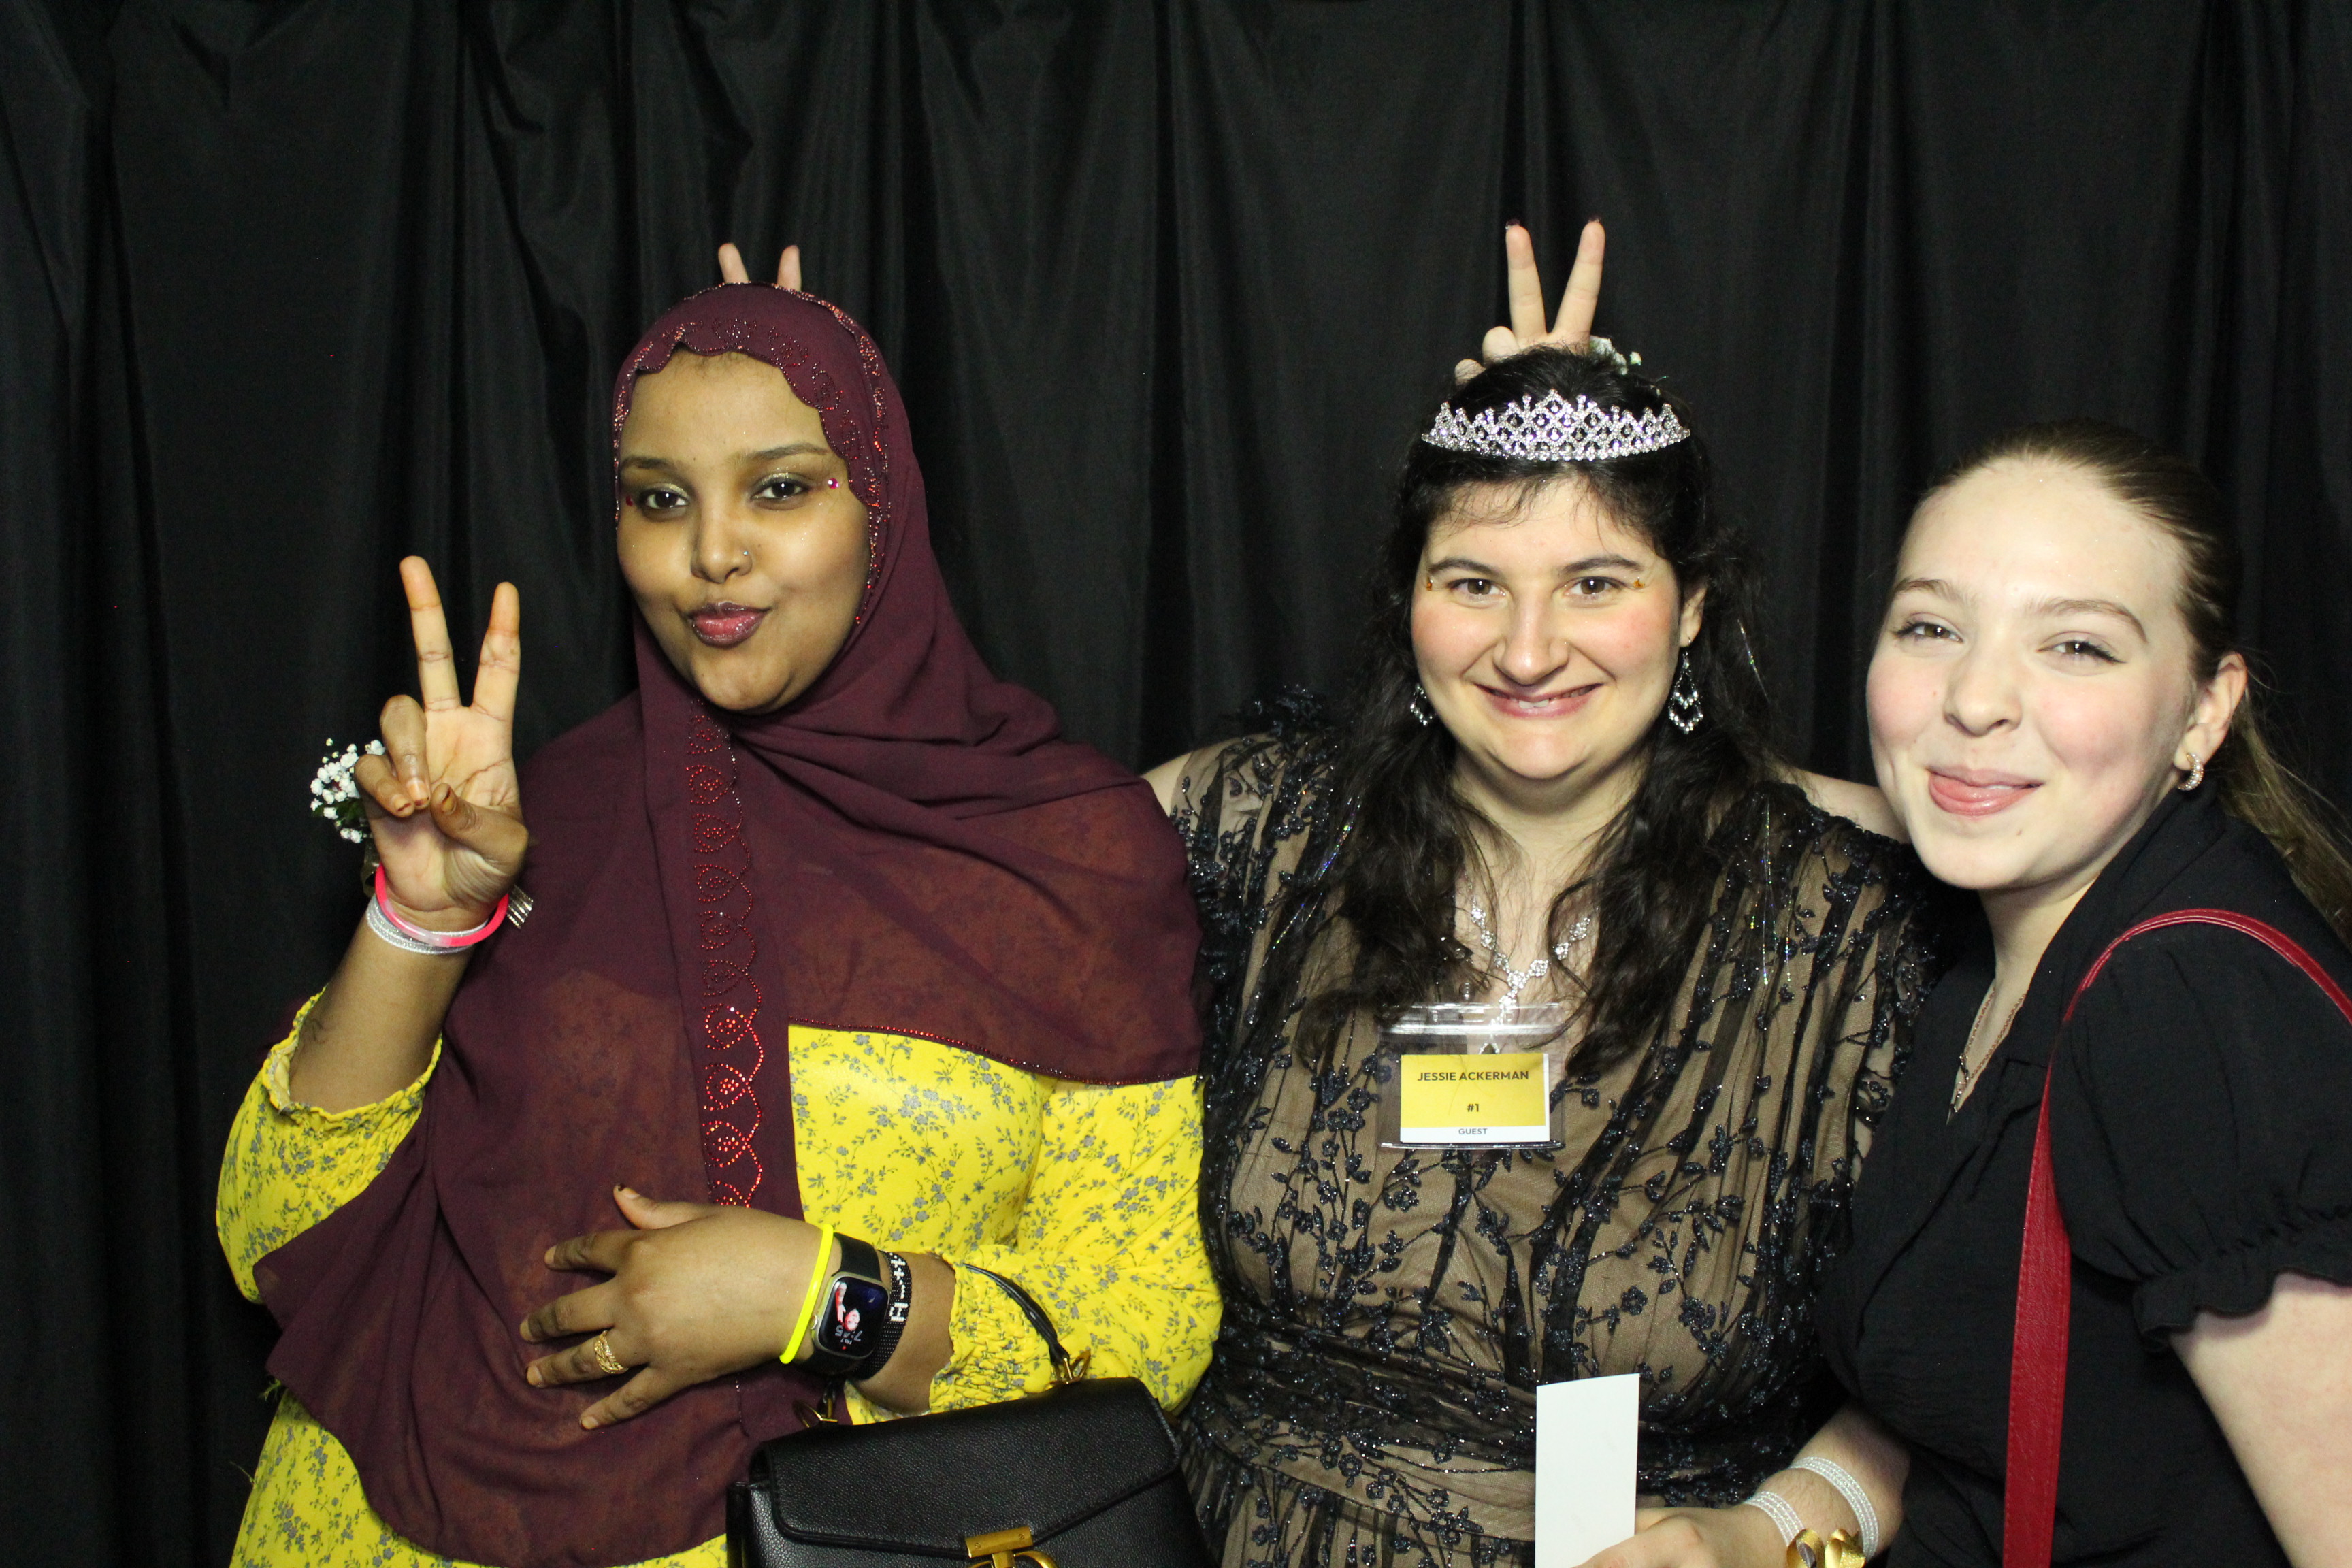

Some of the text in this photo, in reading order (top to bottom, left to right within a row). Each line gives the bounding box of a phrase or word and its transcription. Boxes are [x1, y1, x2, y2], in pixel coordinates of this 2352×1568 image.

[1418, 1071, 1529, 1081] JESSIE ACKERMAN
[1467, 1103, 1480, 1113] #1
